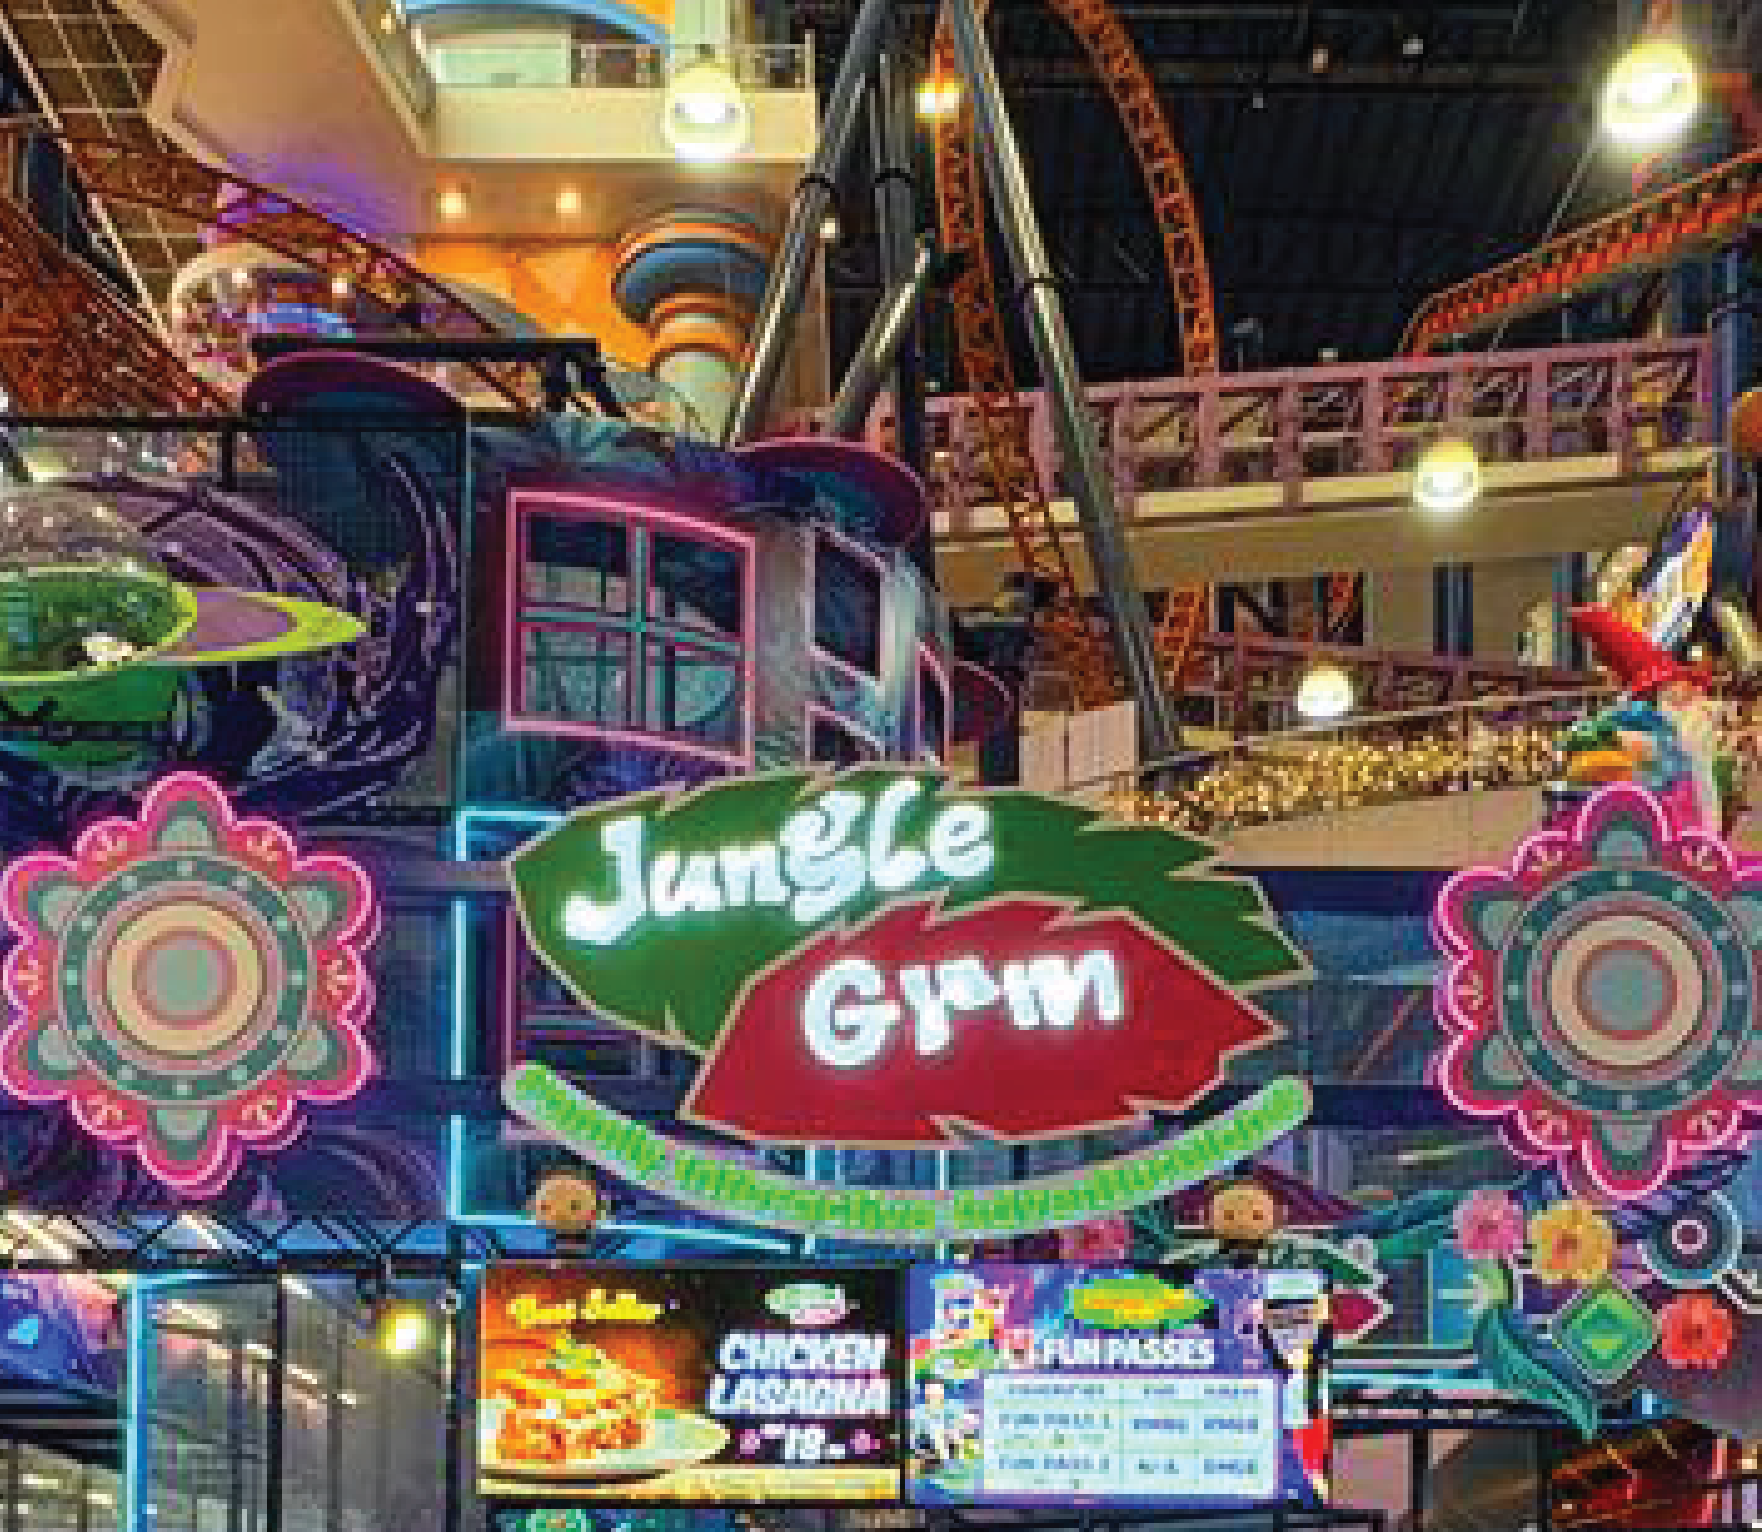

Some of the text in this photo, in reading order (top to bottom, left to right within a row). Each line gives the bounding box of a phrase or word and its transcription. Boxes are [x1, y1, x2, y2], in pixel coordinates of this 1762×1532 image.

[561, 779, 995, 948] Jungle
[799, 948, 1126, 1069] Gym
[717, 1331, 890, 1373] CHICKEN
[1043, 1337, 1216, 1370] FUN PASSES
[705, 1373, 892, 1417] LASAGNA
